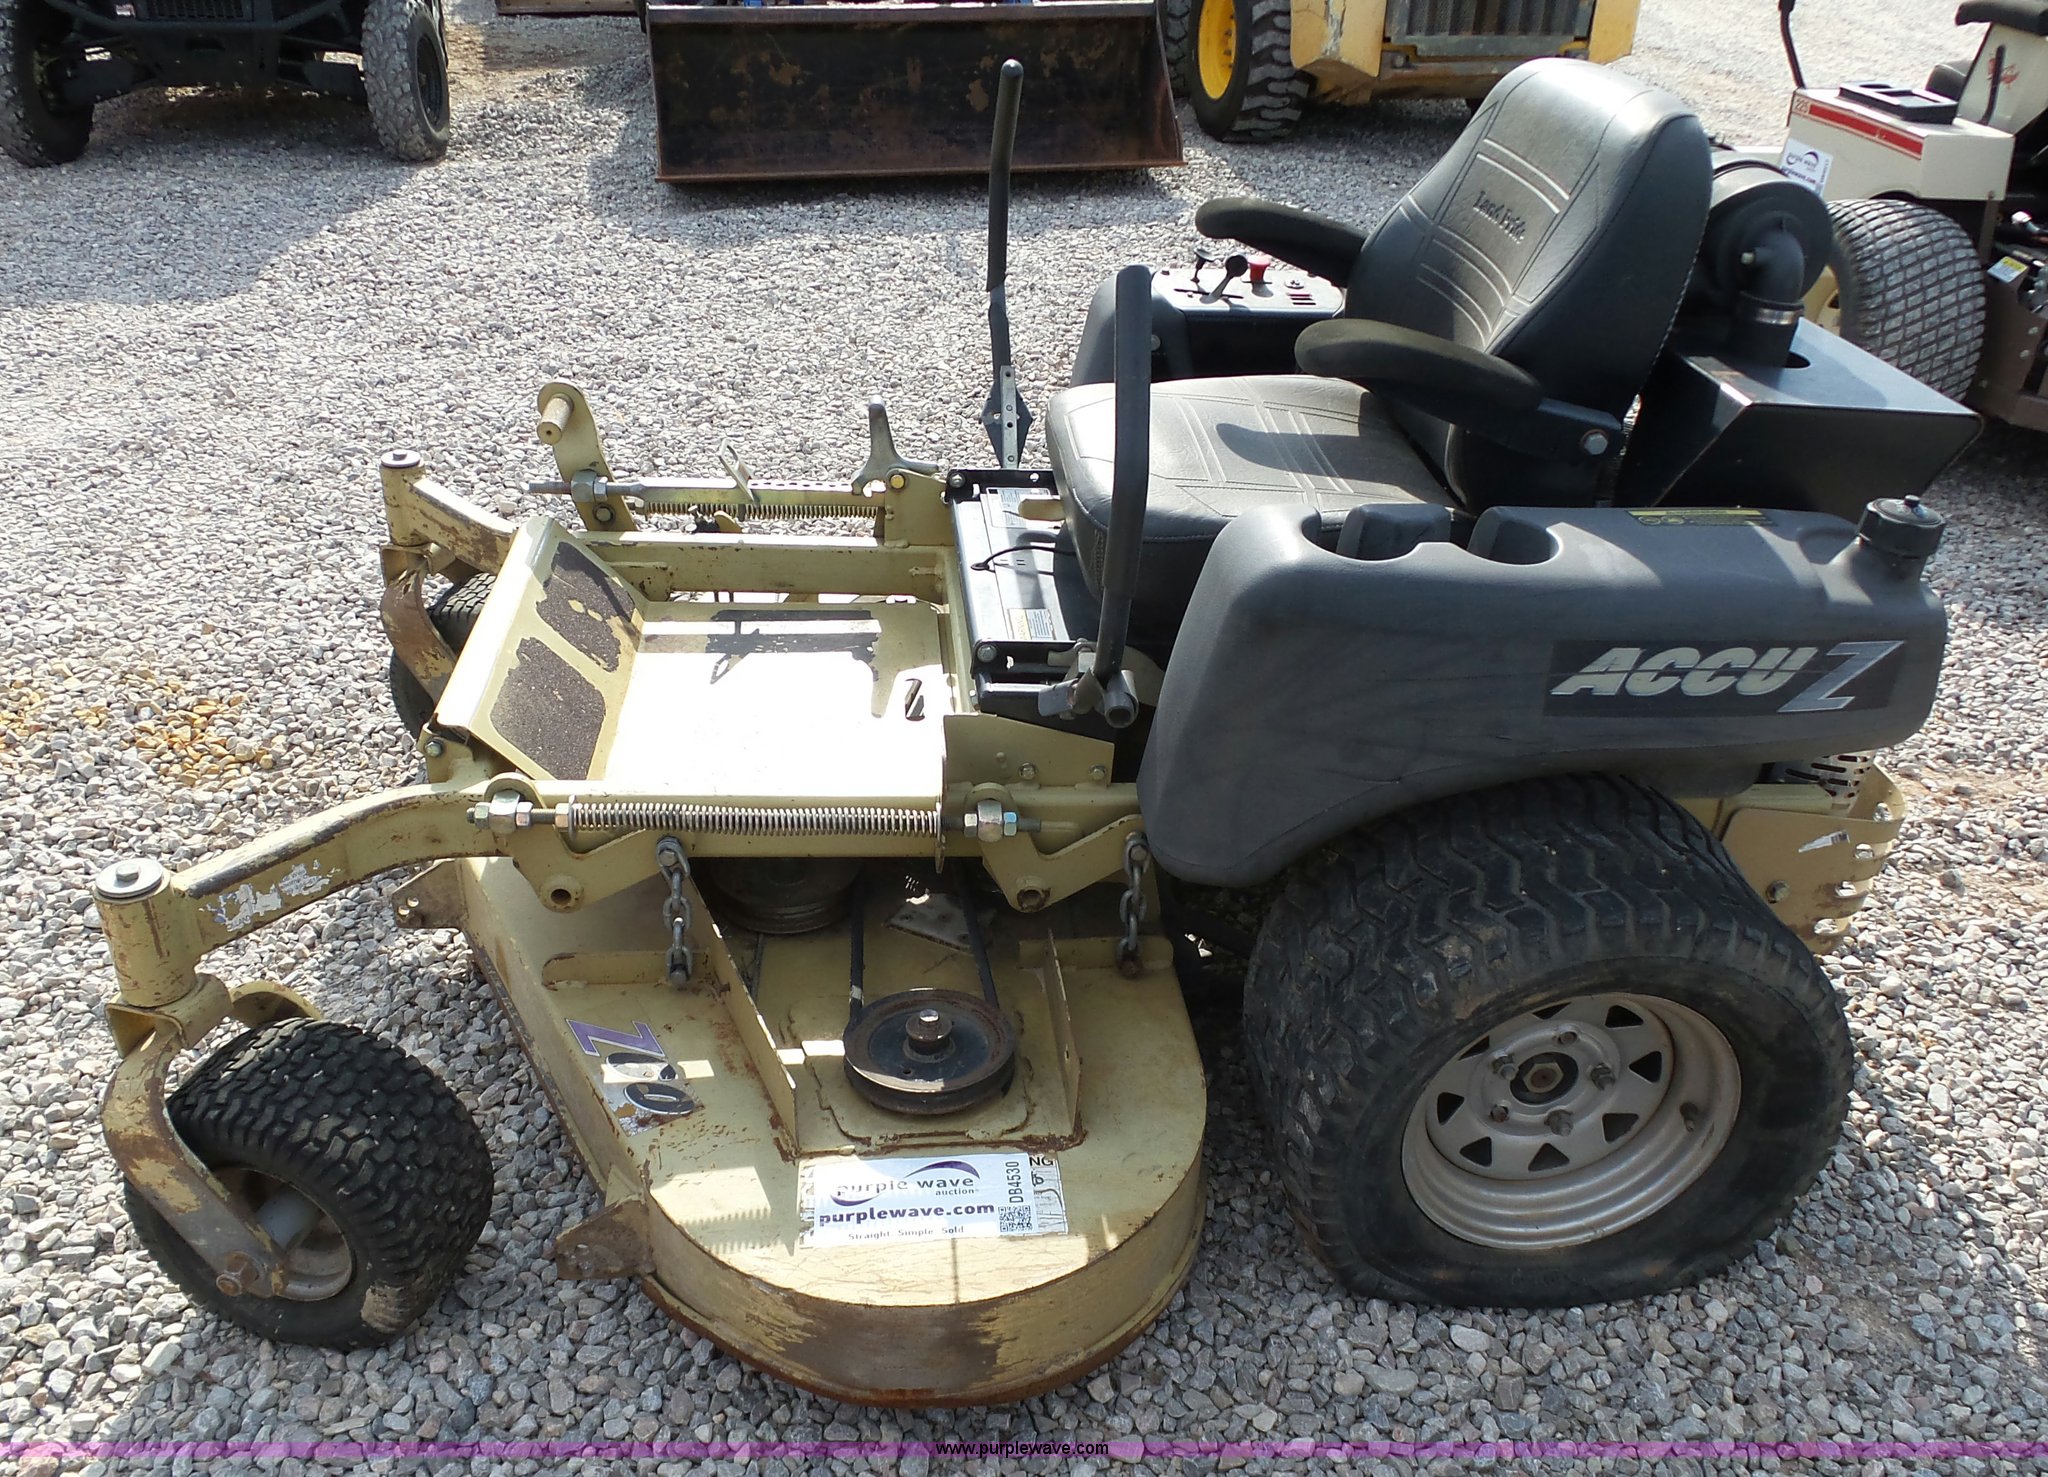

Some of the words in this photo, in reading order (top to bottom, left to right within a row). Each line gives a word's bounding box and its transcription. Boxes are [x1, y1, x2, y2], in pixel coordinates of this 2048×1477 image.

[916, 1178, 974, 1189] wave
[1005, 1161, 1024, 1203] DB4530
[935, 1188, 975, 1196] auction
[819, 1204, 995, 1227] purplewave.com
